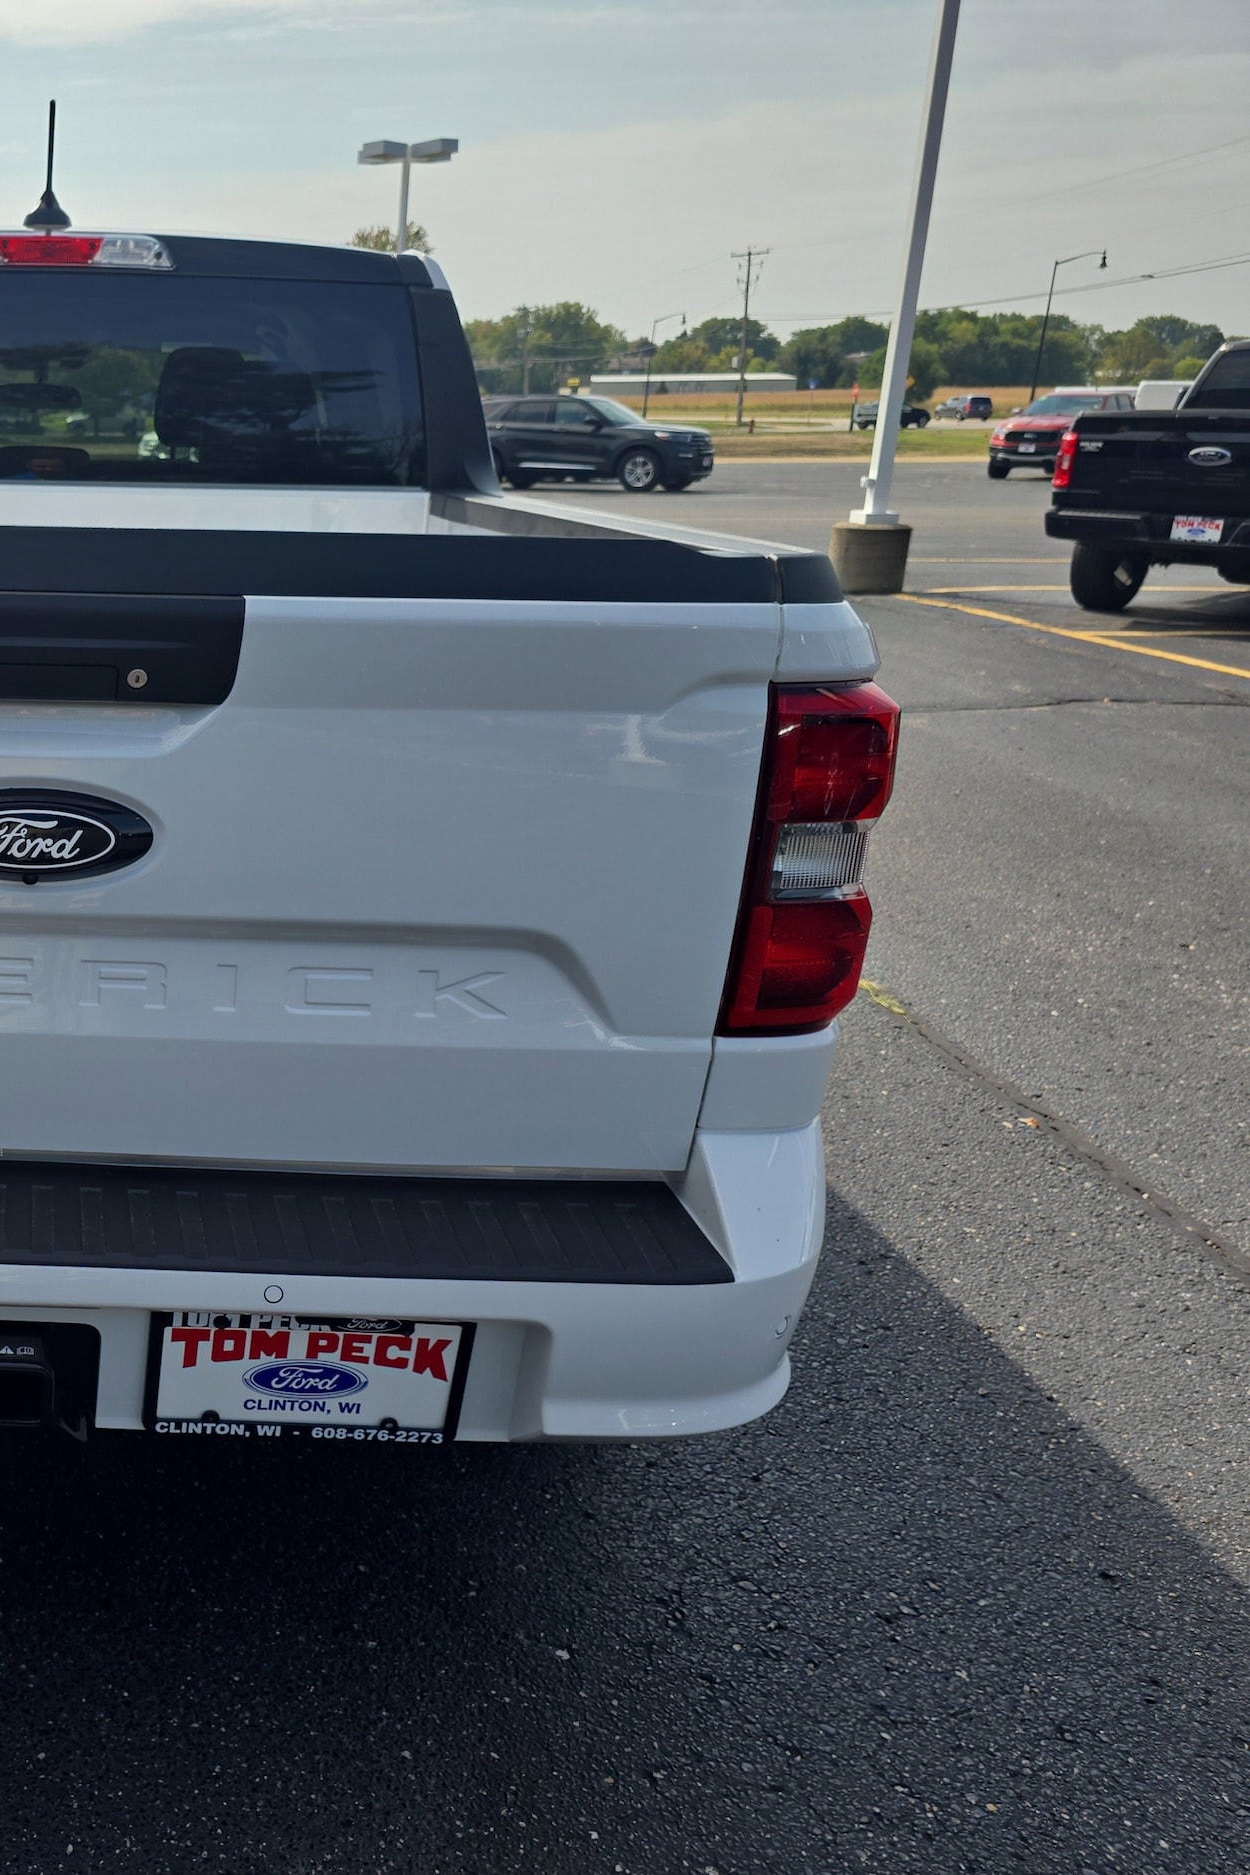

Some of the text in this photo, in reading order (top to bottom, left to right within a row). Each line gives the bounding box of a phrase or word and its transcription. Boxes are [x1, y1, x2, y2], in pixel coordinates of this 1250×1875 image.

[347, 1318, 388, 1330] Ford
[171, 1328, 452, 1382] TOM PECK
[271, 1366, 338, 1391] Ford
[243, 1399, 362, 1414] CLINTON, WI
[155, 1422, 250, 1438] CLINTON,
[257, 1425, 282, 1437] WI
[311, 1427, 444, 1444] 608-676-2273
